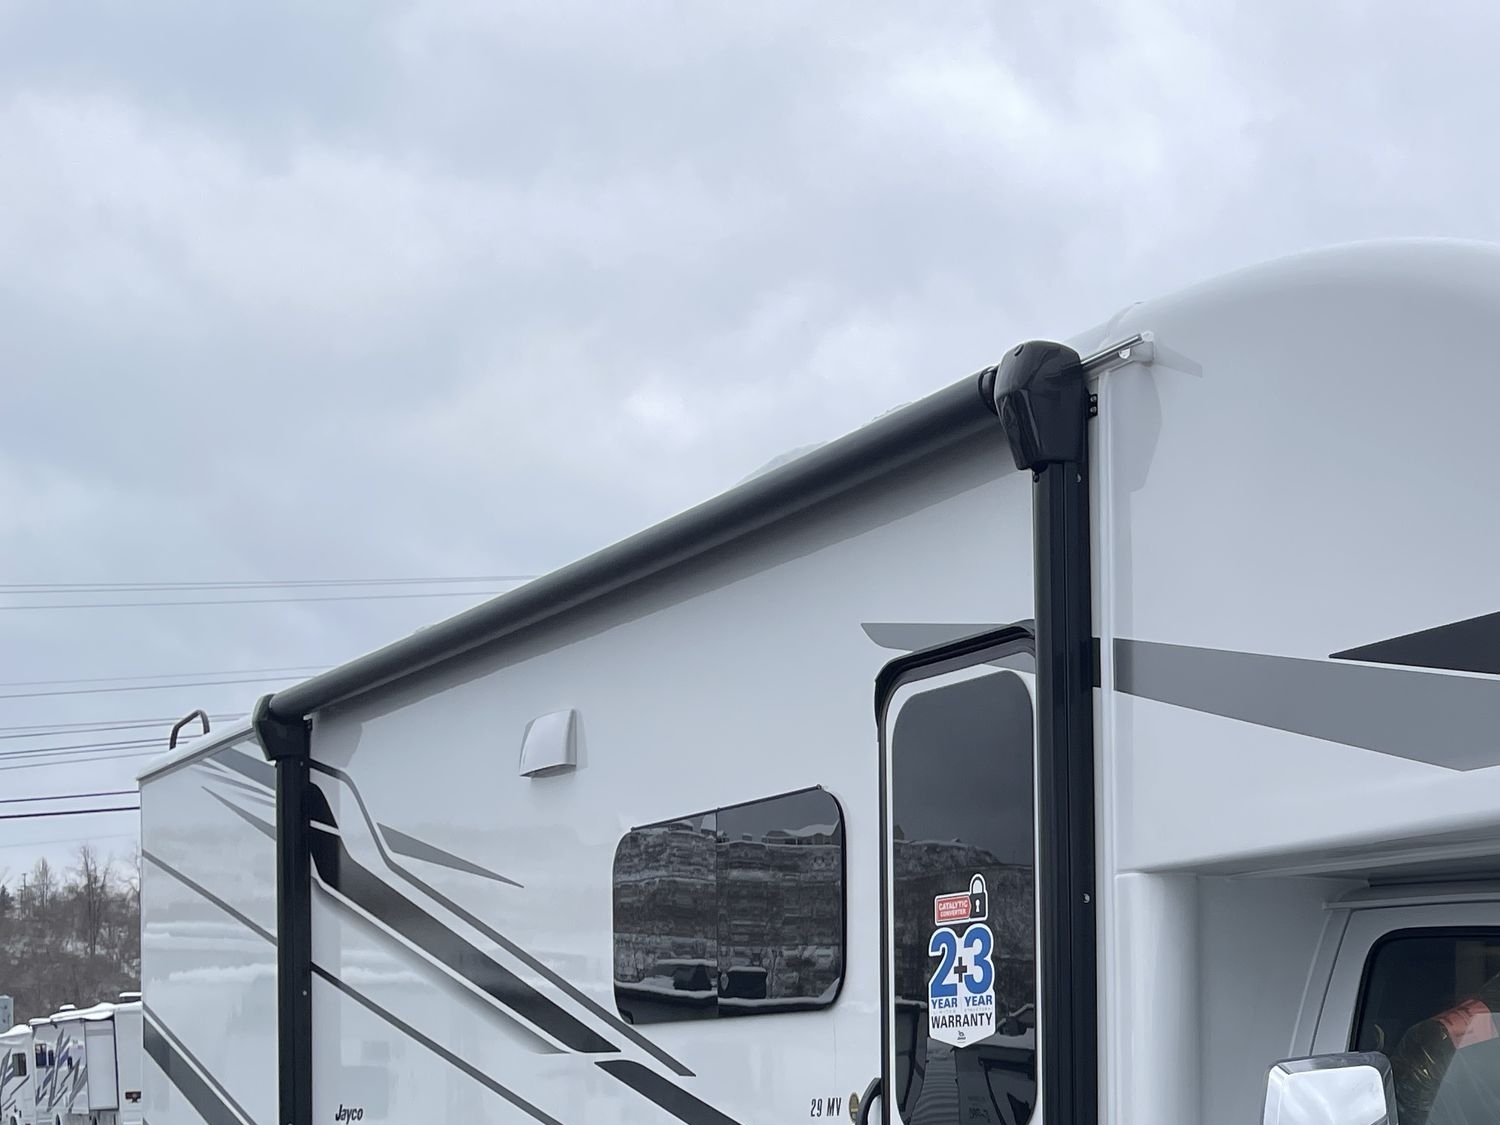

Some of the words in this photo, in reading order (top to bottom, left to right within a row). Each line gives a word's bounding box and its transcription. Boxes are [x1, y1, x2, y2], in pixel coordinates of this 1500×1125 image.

[938, 900, 968, 911] CATALYTIC
[931, 997, 958, 1009] YEAR
[964, 995, 993, 1007] YEAR
[931, 1012, 993, 1030] WARRANTY
[335, 1104, 364, 1125] Jayco
[810, 1098, 823, 1118] 29
[826, 1097, 842, 1117] MV
